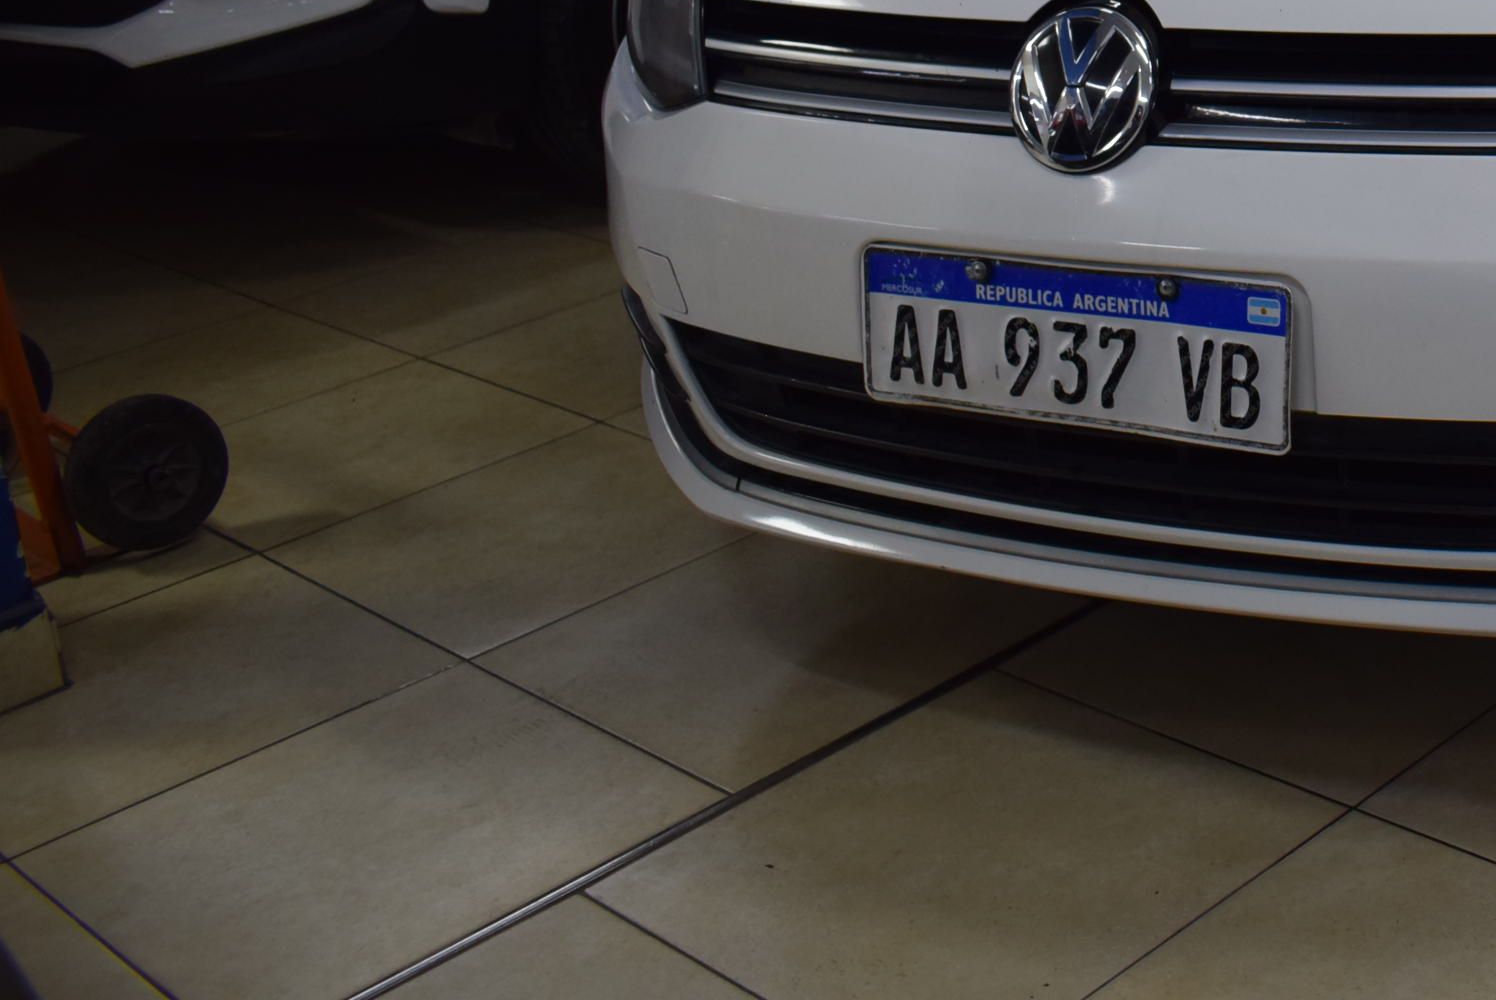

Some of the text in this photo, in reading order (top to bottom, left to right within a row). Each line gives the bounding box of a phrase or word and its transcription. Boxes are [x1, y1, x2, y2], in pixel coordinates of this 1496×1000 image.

[975, 283, 1170, 318] REPUBLICA ARGENTINA
[889, 304, 1261, 430] AA 937 VB
